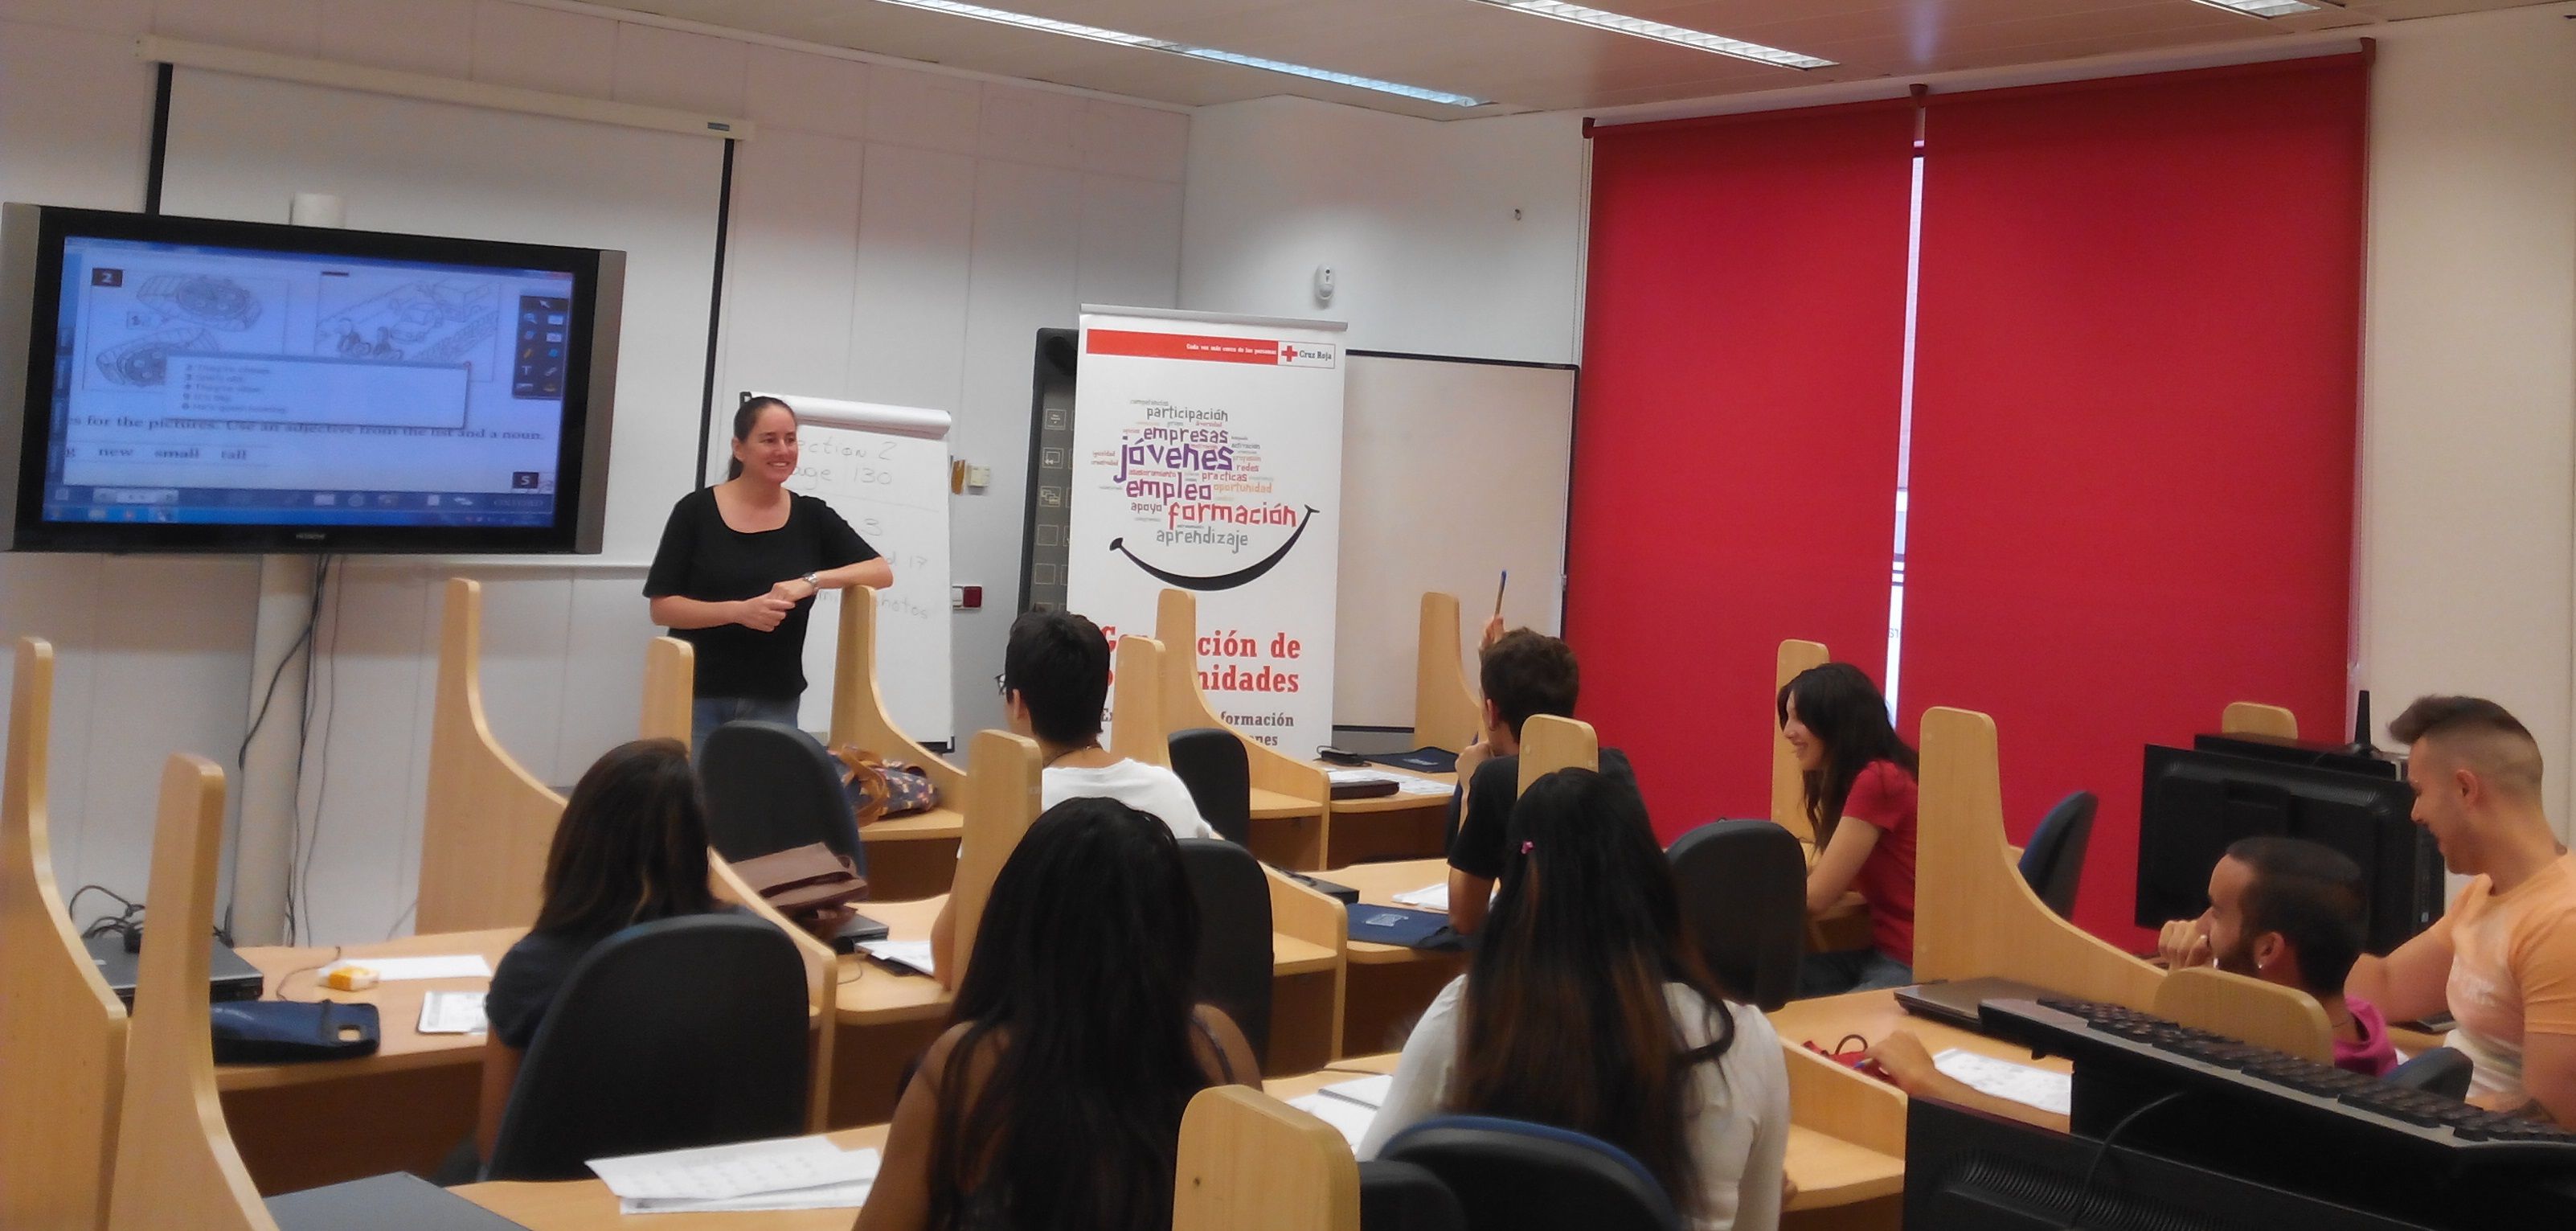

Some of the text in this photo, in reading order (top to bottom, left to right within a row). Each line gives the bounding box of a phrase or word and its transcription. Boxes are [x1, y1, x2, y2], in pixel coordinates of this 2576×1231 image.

[102, 273, 112, 283] 2
[1300, 350, 1332, 361] Cruz Roja
[1147, 405, 1228, 422] participación
[88, 416, 109, 426] for
[117, 416, 143, 427] the
[403, 425, 426, 437] the
[458, 429, 485, 439] and
[1144, 427, 1228, 445] empresas
[99, 449, 247, 461] new small tall
[799, 437, 896, 461] ection 2
[1113, 436, 1234, 483] jóvenes
[1236, 463, 1259, 472] redes
[791, 466, 892, 490] age 130
[1214, 482, 1272, 494] oportunidad
[1126, 472, 1211, 506] empleo
[1131, 502, 1162, 514] apoyo
[1168, 502, 1296, 531] formación
[1156, 526, 1248, 554] aprendizaje
[881, 593, 928, 619] hotos
[1270, 631, 1301, 659] de
[1220, 710, 1294, 727] formación
